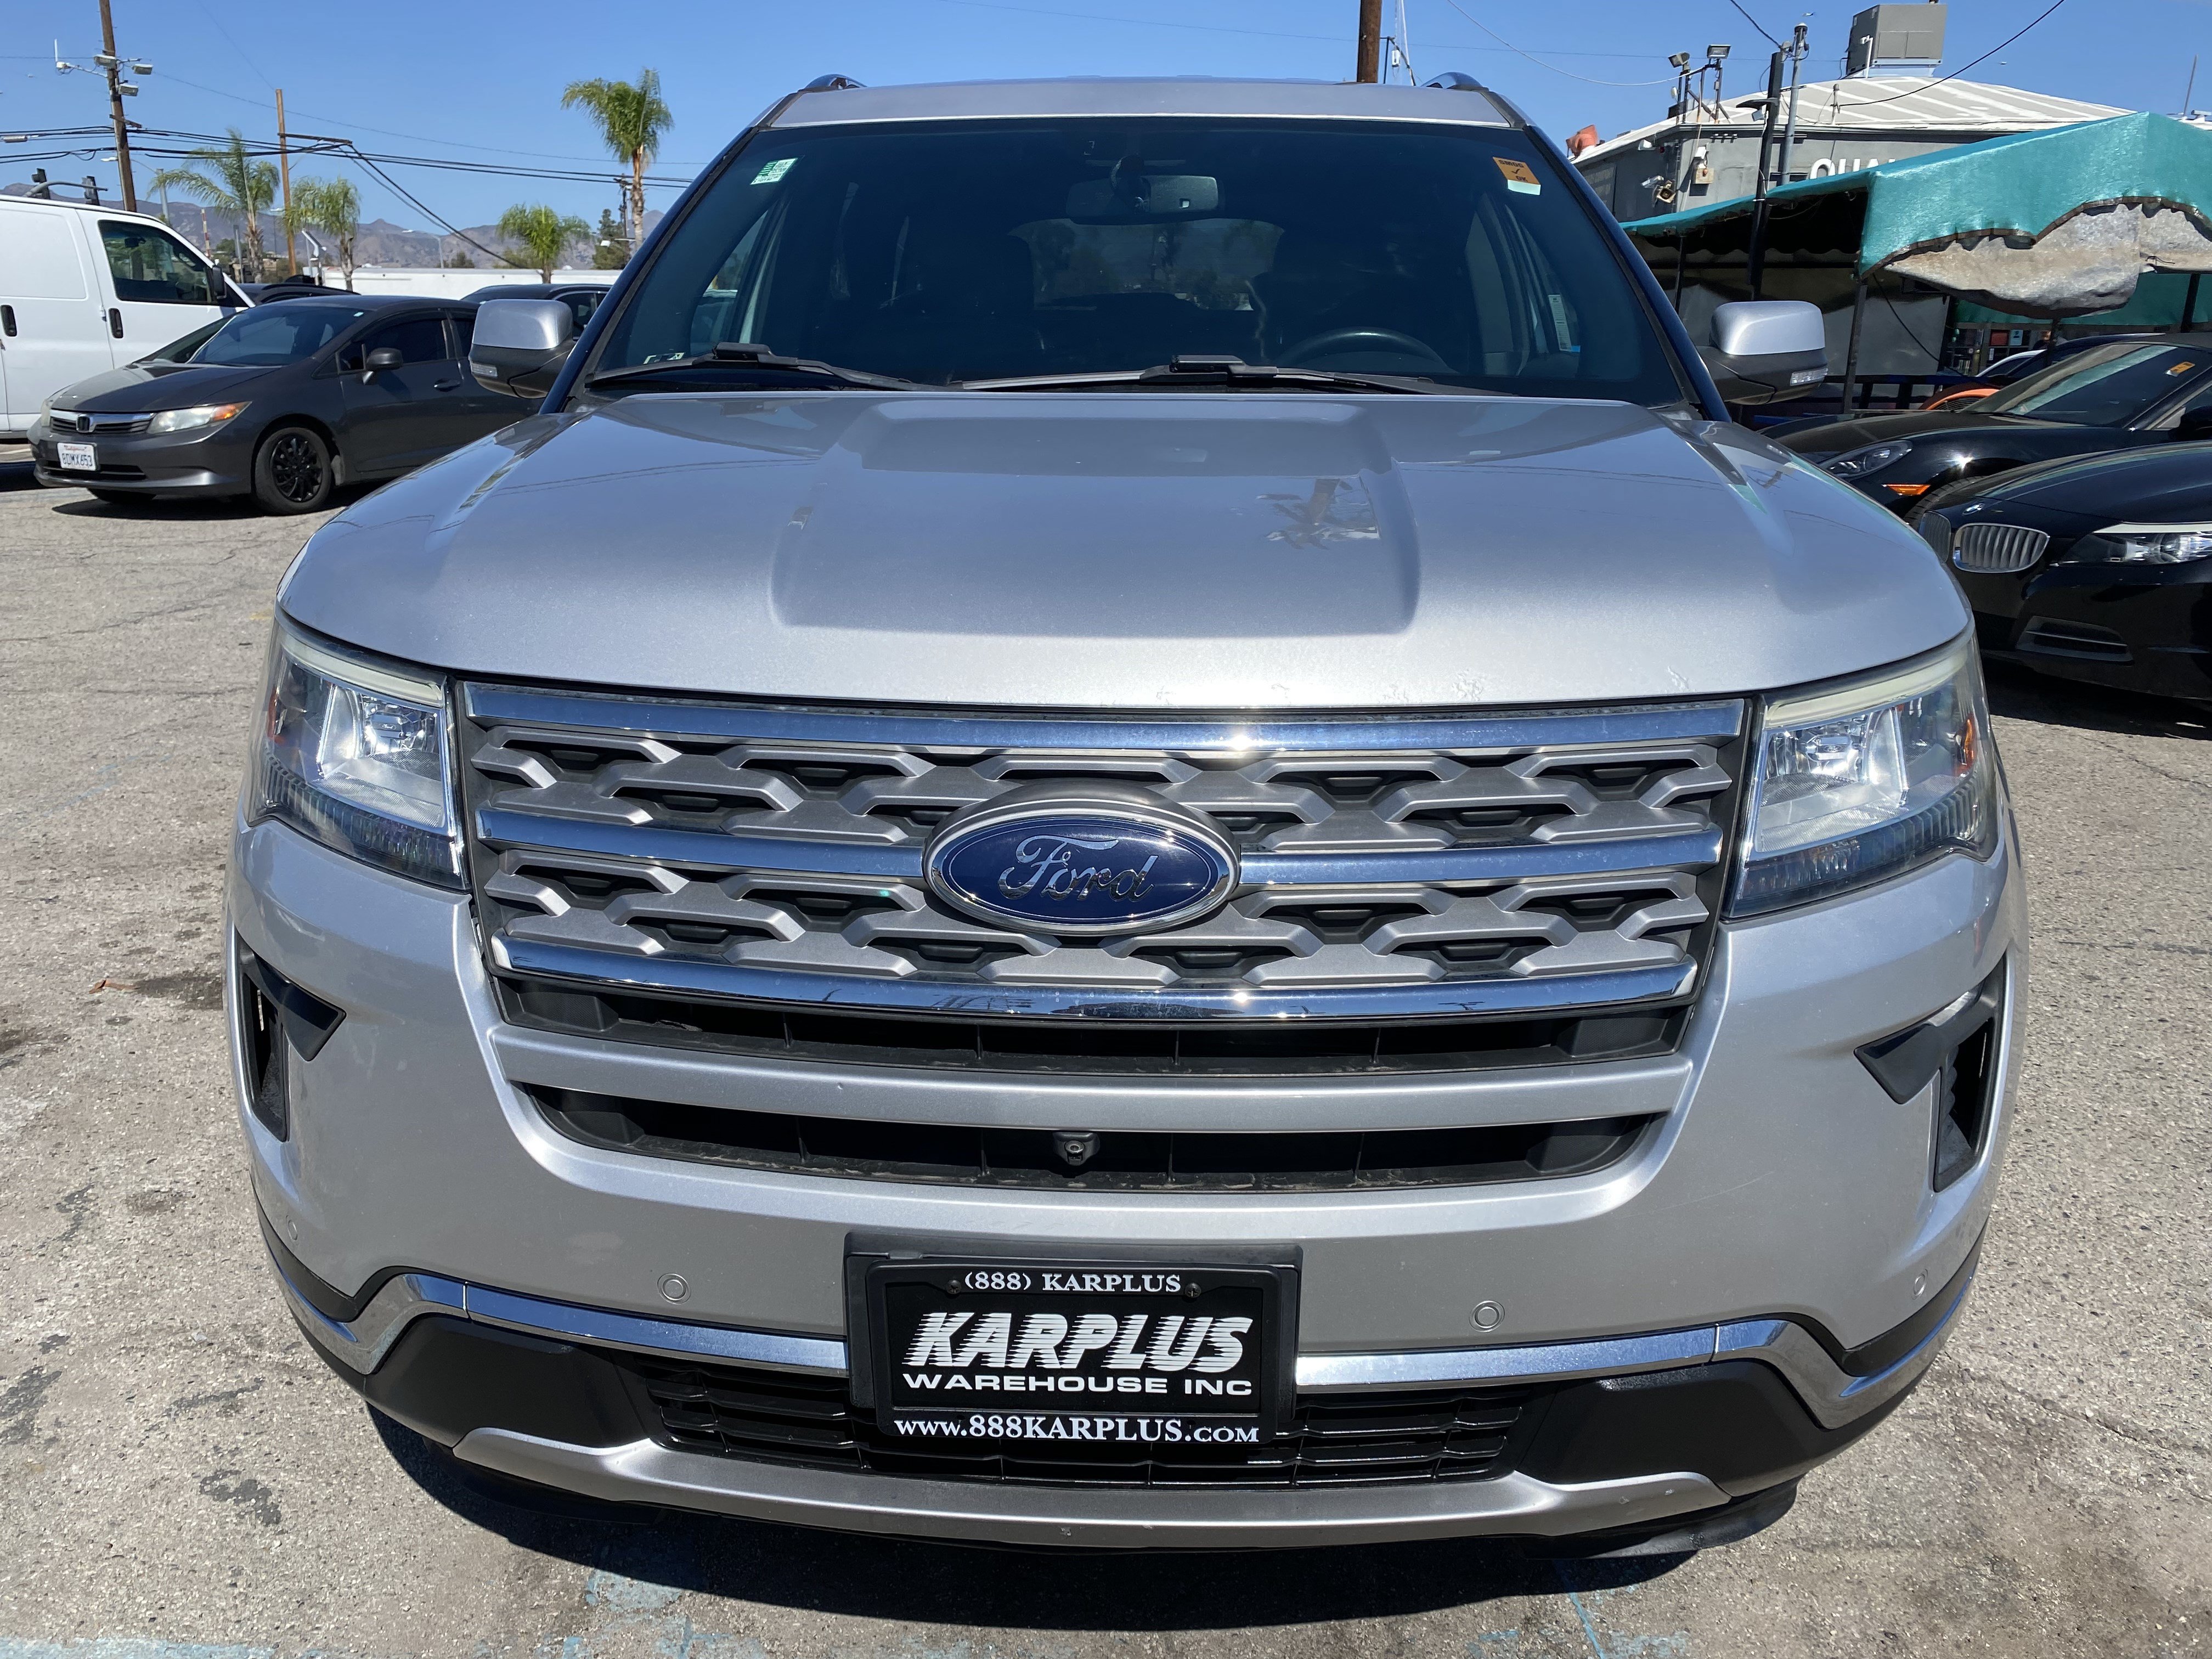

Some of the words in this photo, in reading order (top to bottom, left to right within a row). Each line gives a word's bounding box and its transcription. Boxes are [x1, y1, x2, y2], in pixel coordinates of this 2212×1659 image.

[997, 835, 1158, 902] Ford
[964, 1271, 1031, 1291] (888)
[1042, 1272, 1181, 1293] KARPLUS
[902, 1312, 1253, 1373] KARPLUS
[902, 1373, 1167, 1394] WAREHOUSE
[1184, 1379, 1252, 1396] INC
